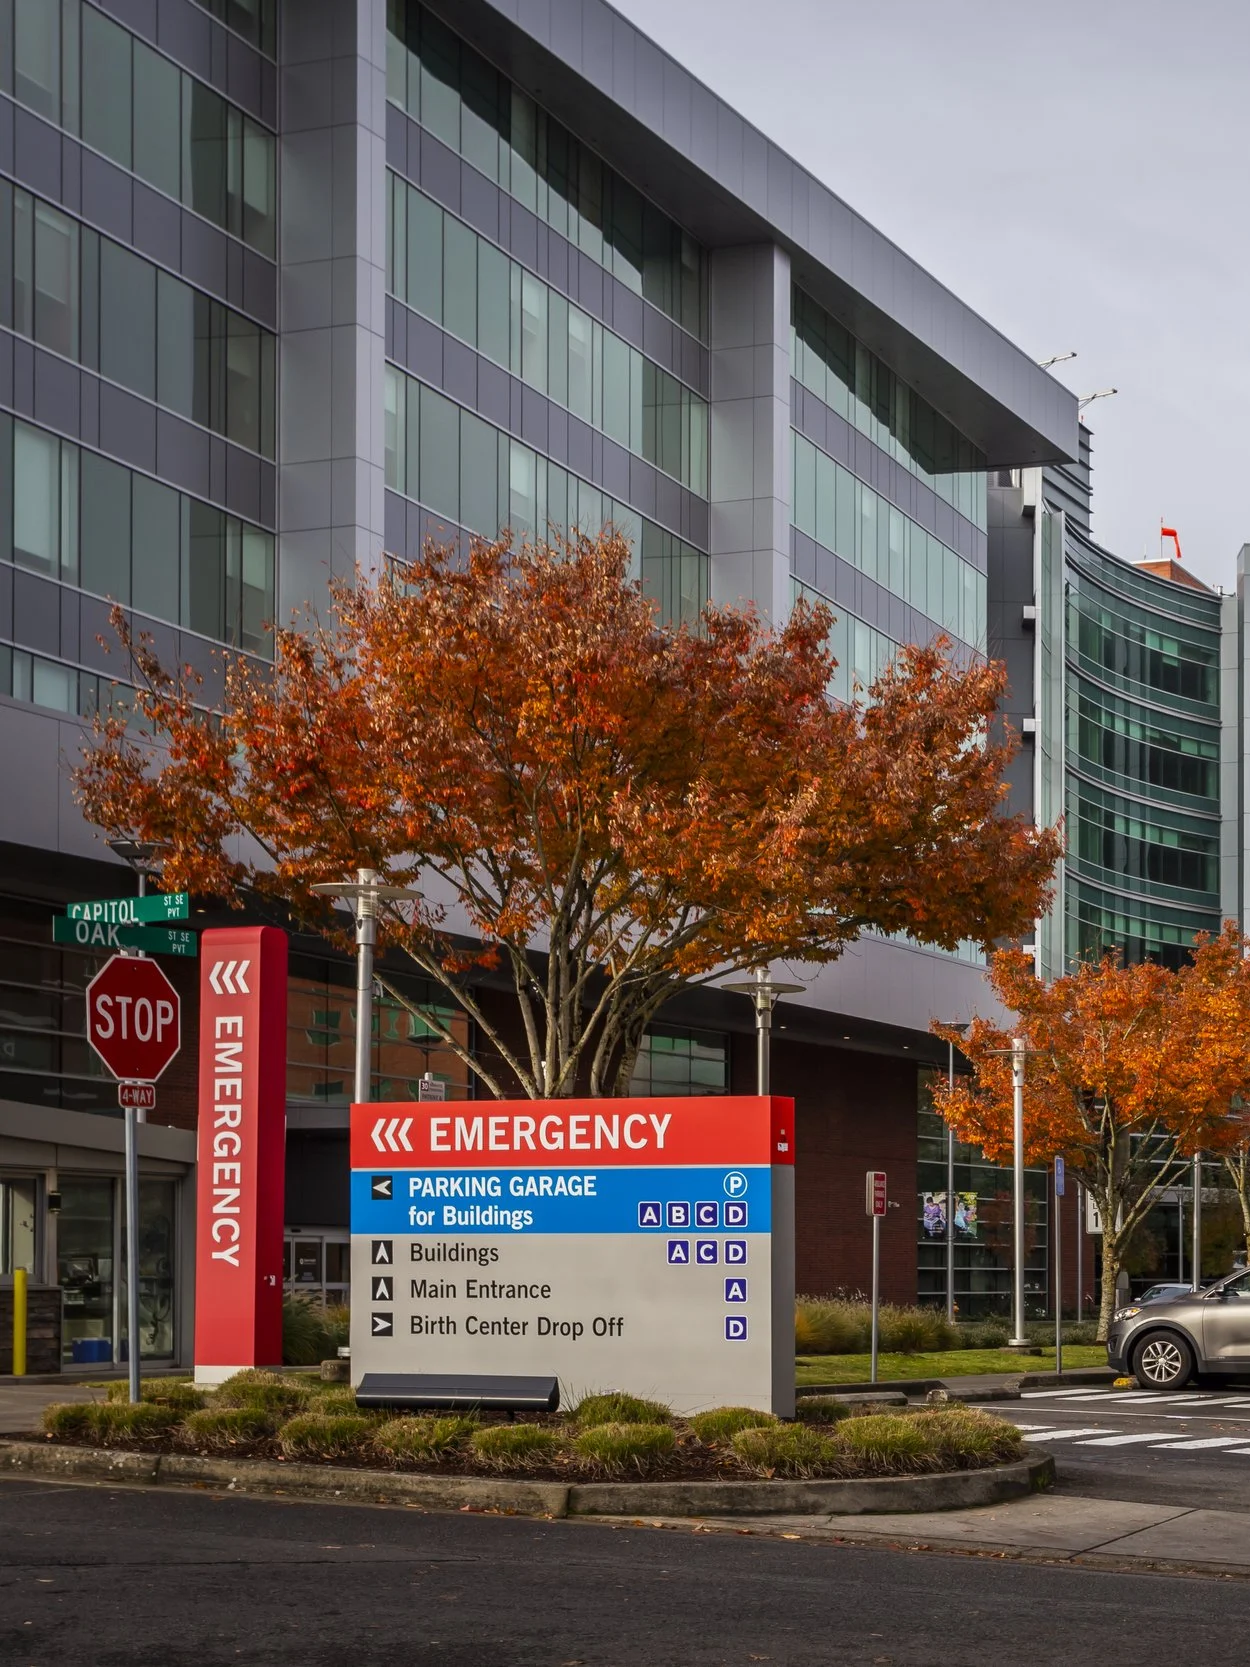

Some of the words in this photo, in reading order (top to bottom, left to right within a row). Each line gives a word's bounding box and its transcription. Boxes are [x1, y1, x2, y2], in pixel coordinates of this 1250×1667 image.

[163, 897, 173, 906] ST
[175, 894, 184, 905] SE
[72, 900, 139, 924] CAPITOL
[167, 908, 180, 918] PVT
[75, 920, 121, 947] OAK
[168, 931, 177, 941] ST
[180, 932, 190, 943] SE
[172, 943, 186, 954] PVT
[95, 994, 174, 1043] STOP
[122, 1088, 153, 1105] 4-WAY
[211, 1015, 243, 1268] EMERGENCY
[430, 1114, 673, 1152] EMERGENCY
[409, 1176, 502, 1198] PARKING
[509, 1175, 597, 1197] GARAGE
[408, 1207, 436, 1226] for
[443, 1206, 534, 1231] Buildings
[642, 1207, 658, 1224] A
[672, 1207, 686, 1224] B
[699, 1206, 714, 1224] C
[728, 1207, 743, 1223] D
[410, 1242, 499, 1266] Buildings
[670, 1245, 687, 1262] A
[699, 1244, 714, 1262] C
[728, 1245, 743, 1261] D
[410, 1279, 457, 1300] Main
[465, 1280, 551, 1300] Entrance
[727, 1283, 744, 1300] A
[410, 1315, 457, 1335] Birth
[465, 1316, 528, 1336] Center
[537, 1317, 584, 1341] Drop
[592, 1317, 624, 1337] Off
[729, 1321, 743, 1337] D
